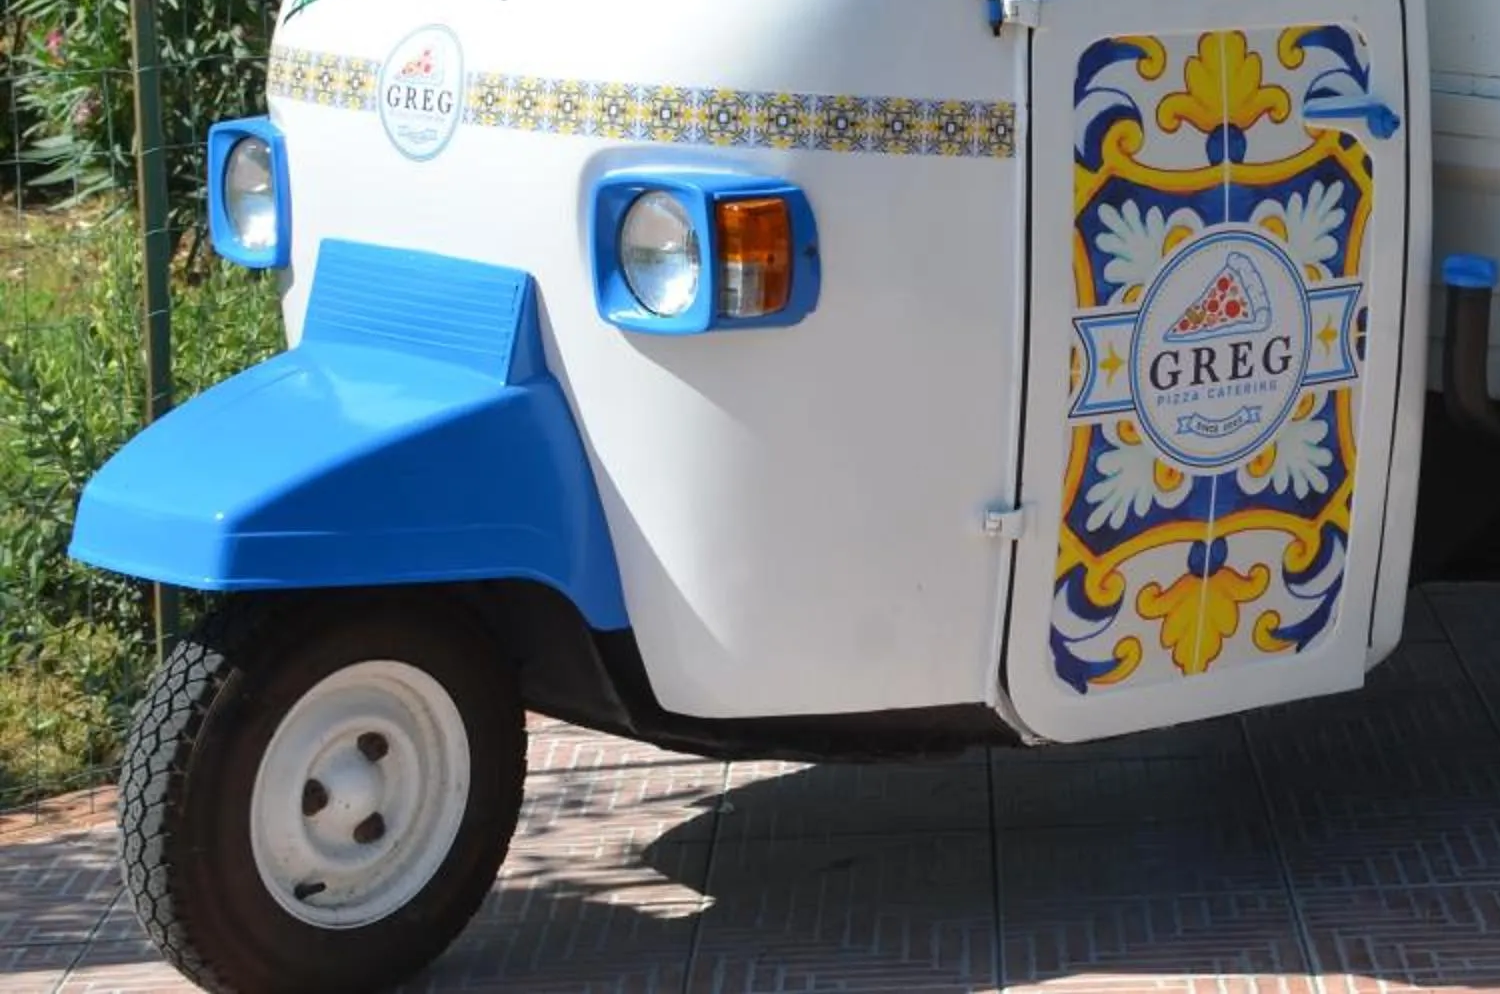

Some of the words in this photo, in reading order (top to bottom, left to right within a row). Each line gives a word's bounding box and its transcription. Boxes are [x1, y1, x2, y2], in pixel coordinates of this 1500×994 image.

[387, 84, 454, 115] GREG
[1150, 335, 1294, 391] GREG
[1157, 388, 1200, 406] PIZZA
[1207, 379, 1279, 399] CATERING
